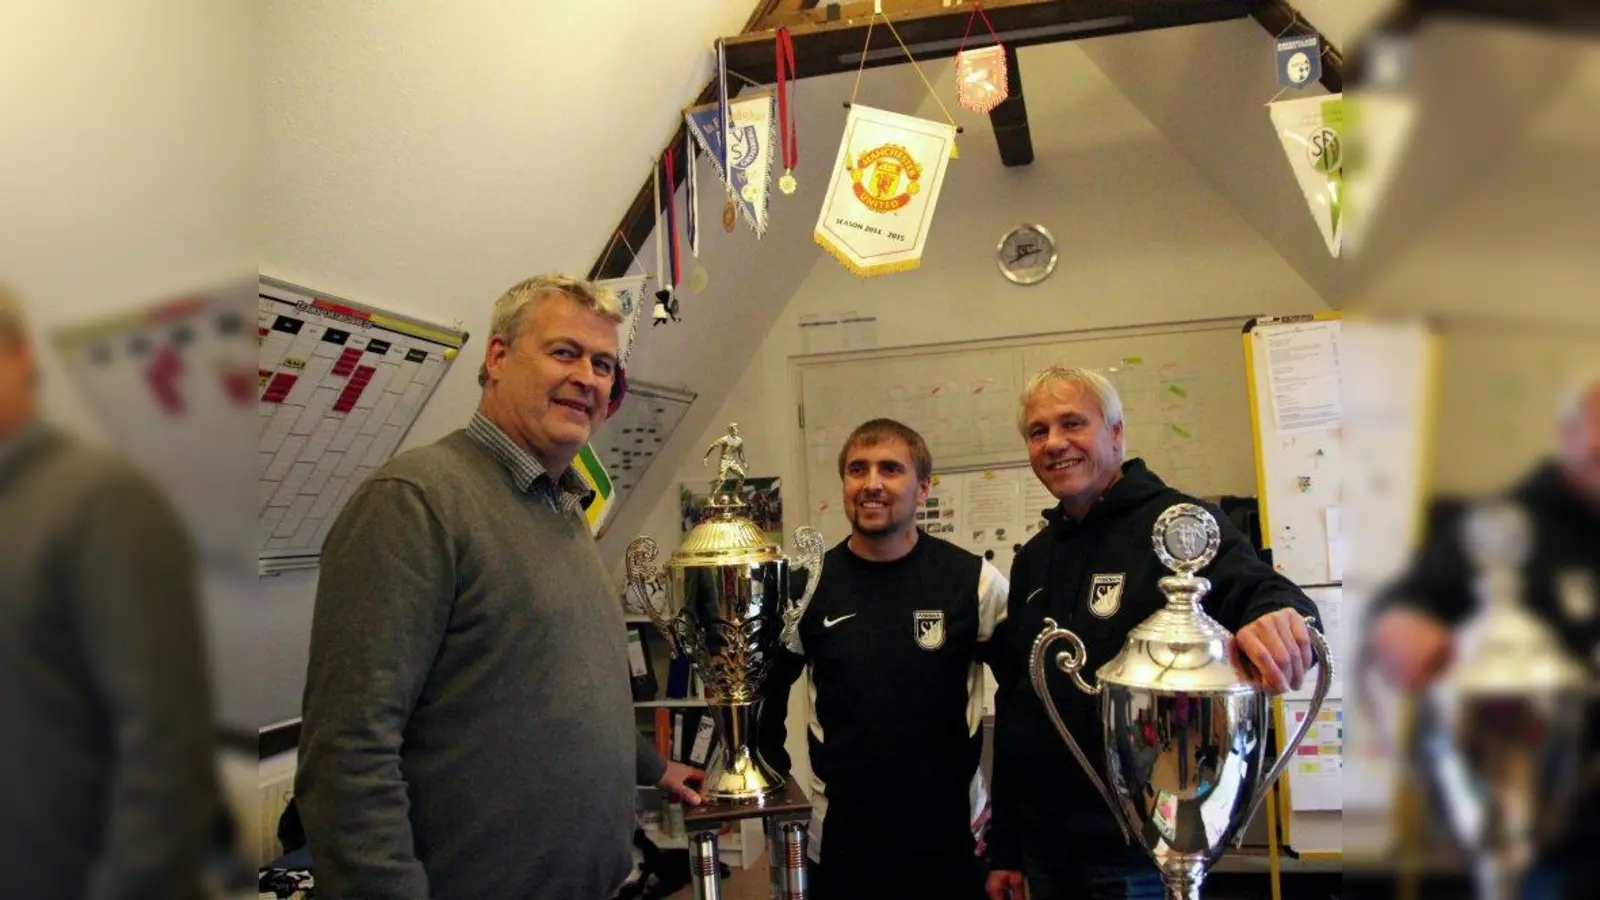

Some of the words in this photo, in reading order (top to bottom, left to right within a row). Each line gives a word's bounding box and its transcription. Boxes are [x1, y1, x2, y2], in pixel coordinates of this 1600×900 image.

[861, 147, 919, 178] MANCHESTER
[860, 192, 900, 209] UNITED
[836, 218, 863, 230] SEASON
[864, 224, 882, 235] 2014
[887, 231, 905, 242] 2015
